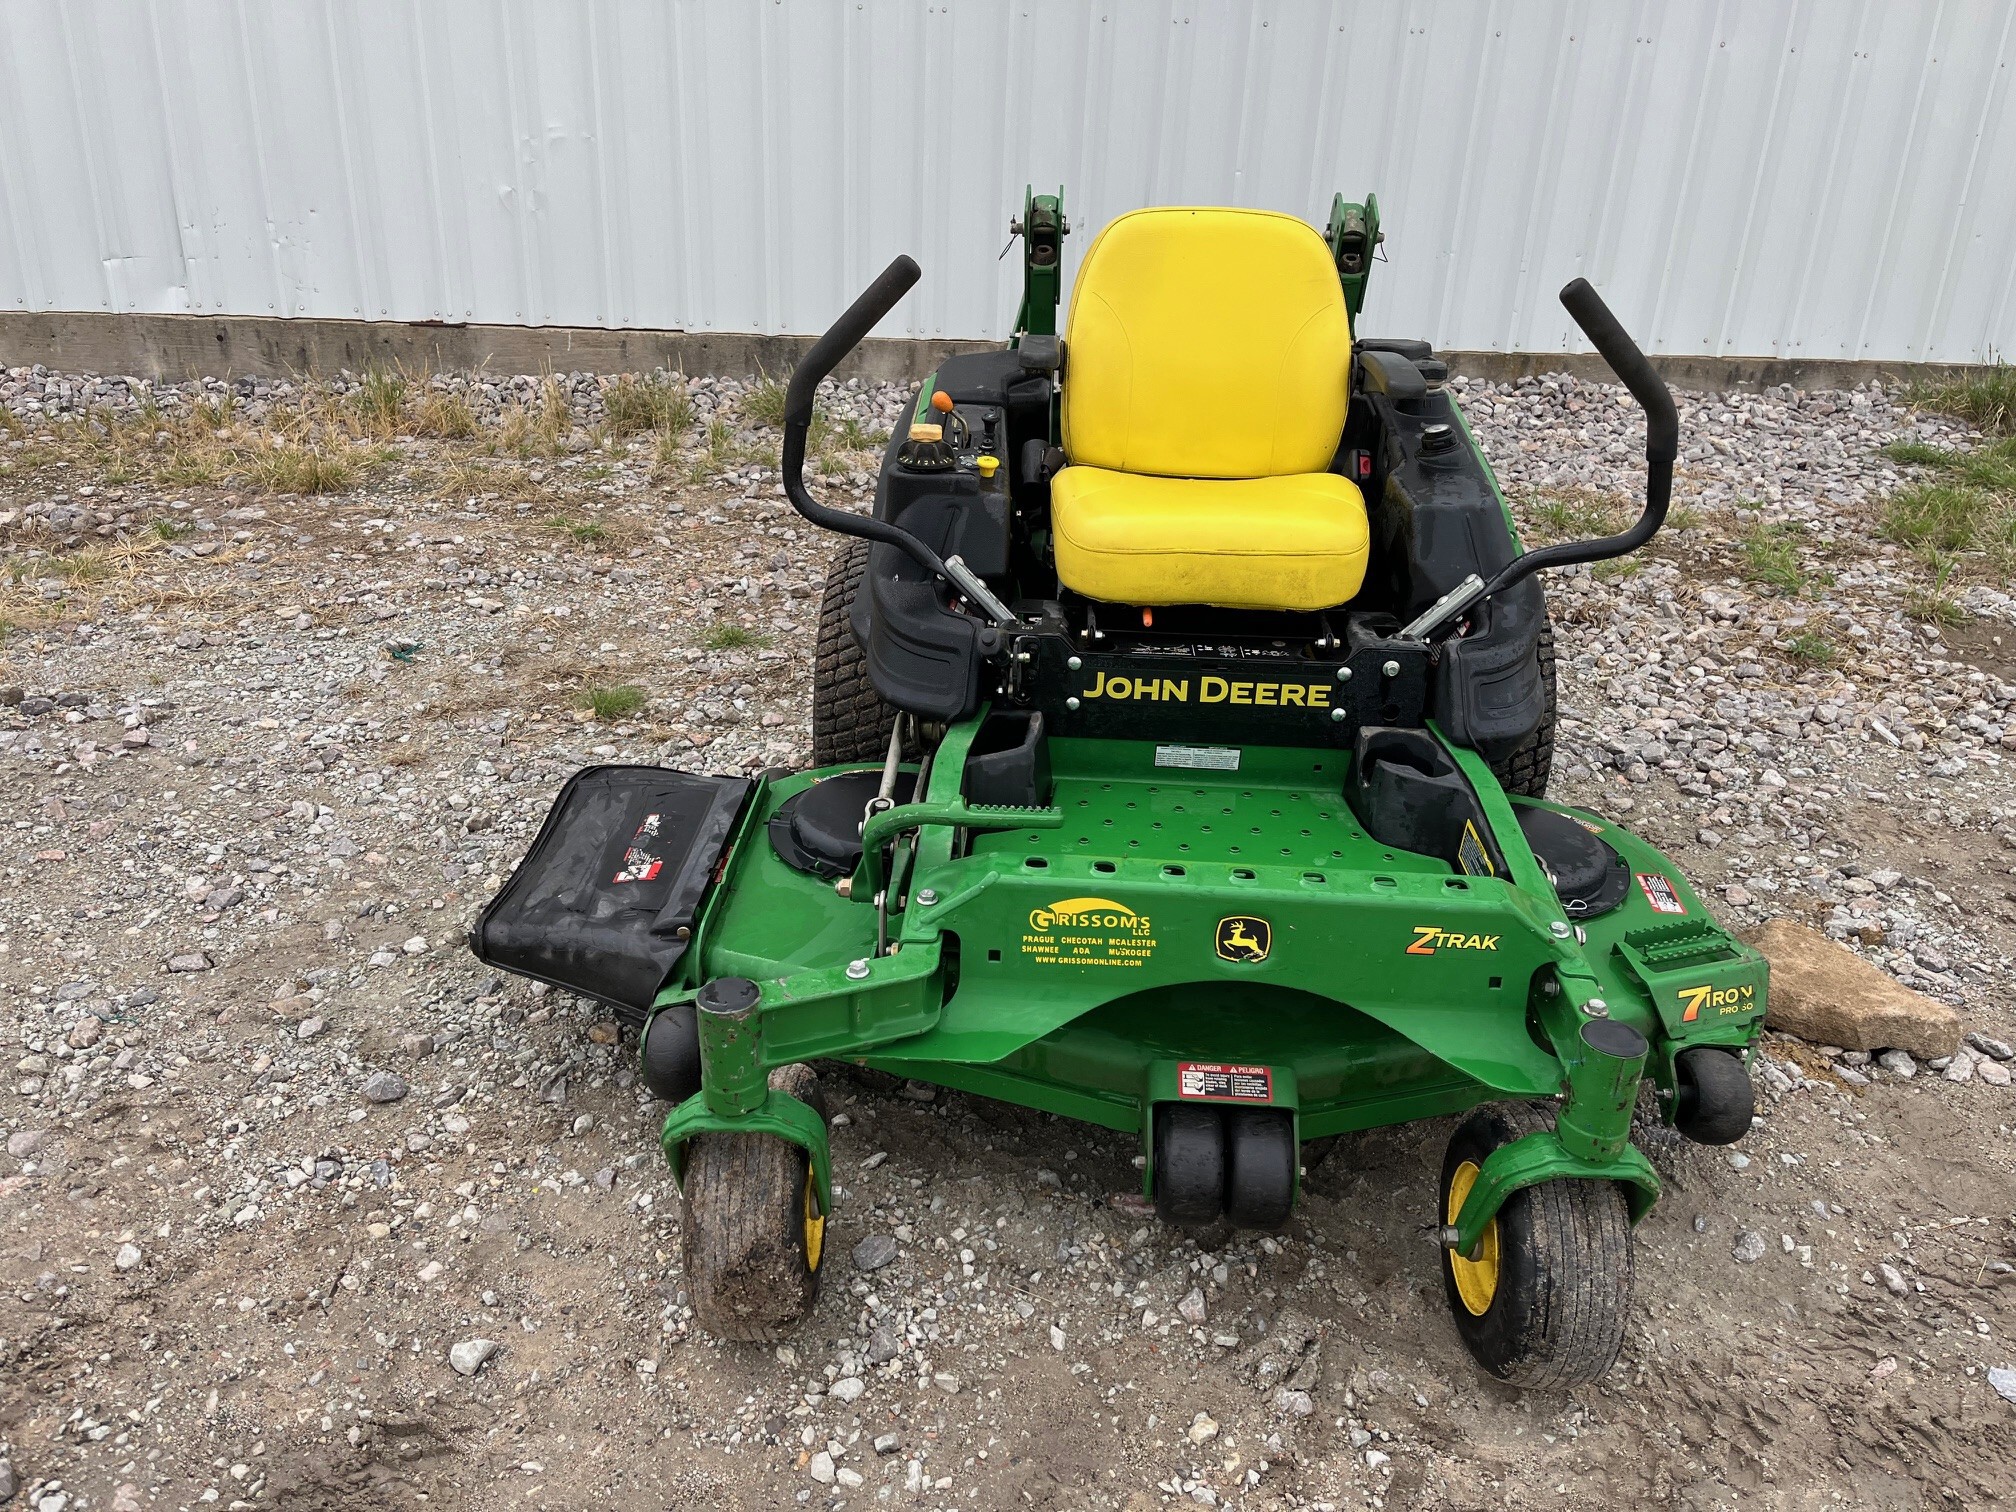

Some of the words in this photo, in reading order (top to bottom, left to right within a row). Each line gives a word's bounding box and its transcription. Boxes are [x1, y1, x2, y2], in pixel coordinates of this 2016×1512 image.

[1083, 671, 1189, 702] JOHN
[1199, 676, 1332, 707] DEERE
[1029, 909, 1151, 932] GRISSOM'S
[1132, 928, 1150, 936] LLC
[1022, 935, 1055, 944] PRAGUE
[1061, 936, 1103, 945] CHECOTAH
[1108, 938, 1157, 947] MCALESTER
[1021, 945, 1059, 954] SHAWNEE
[1072, 947, 1091, 955] ADA
[1108, 948, 1152, 957] MUSKOGEE
[1719, 1005, 1739, 1016] PRO
[1196, 1064, 1222, 1072] DANGER
[1238, 1066, 1264, 1075] PELIGRO
